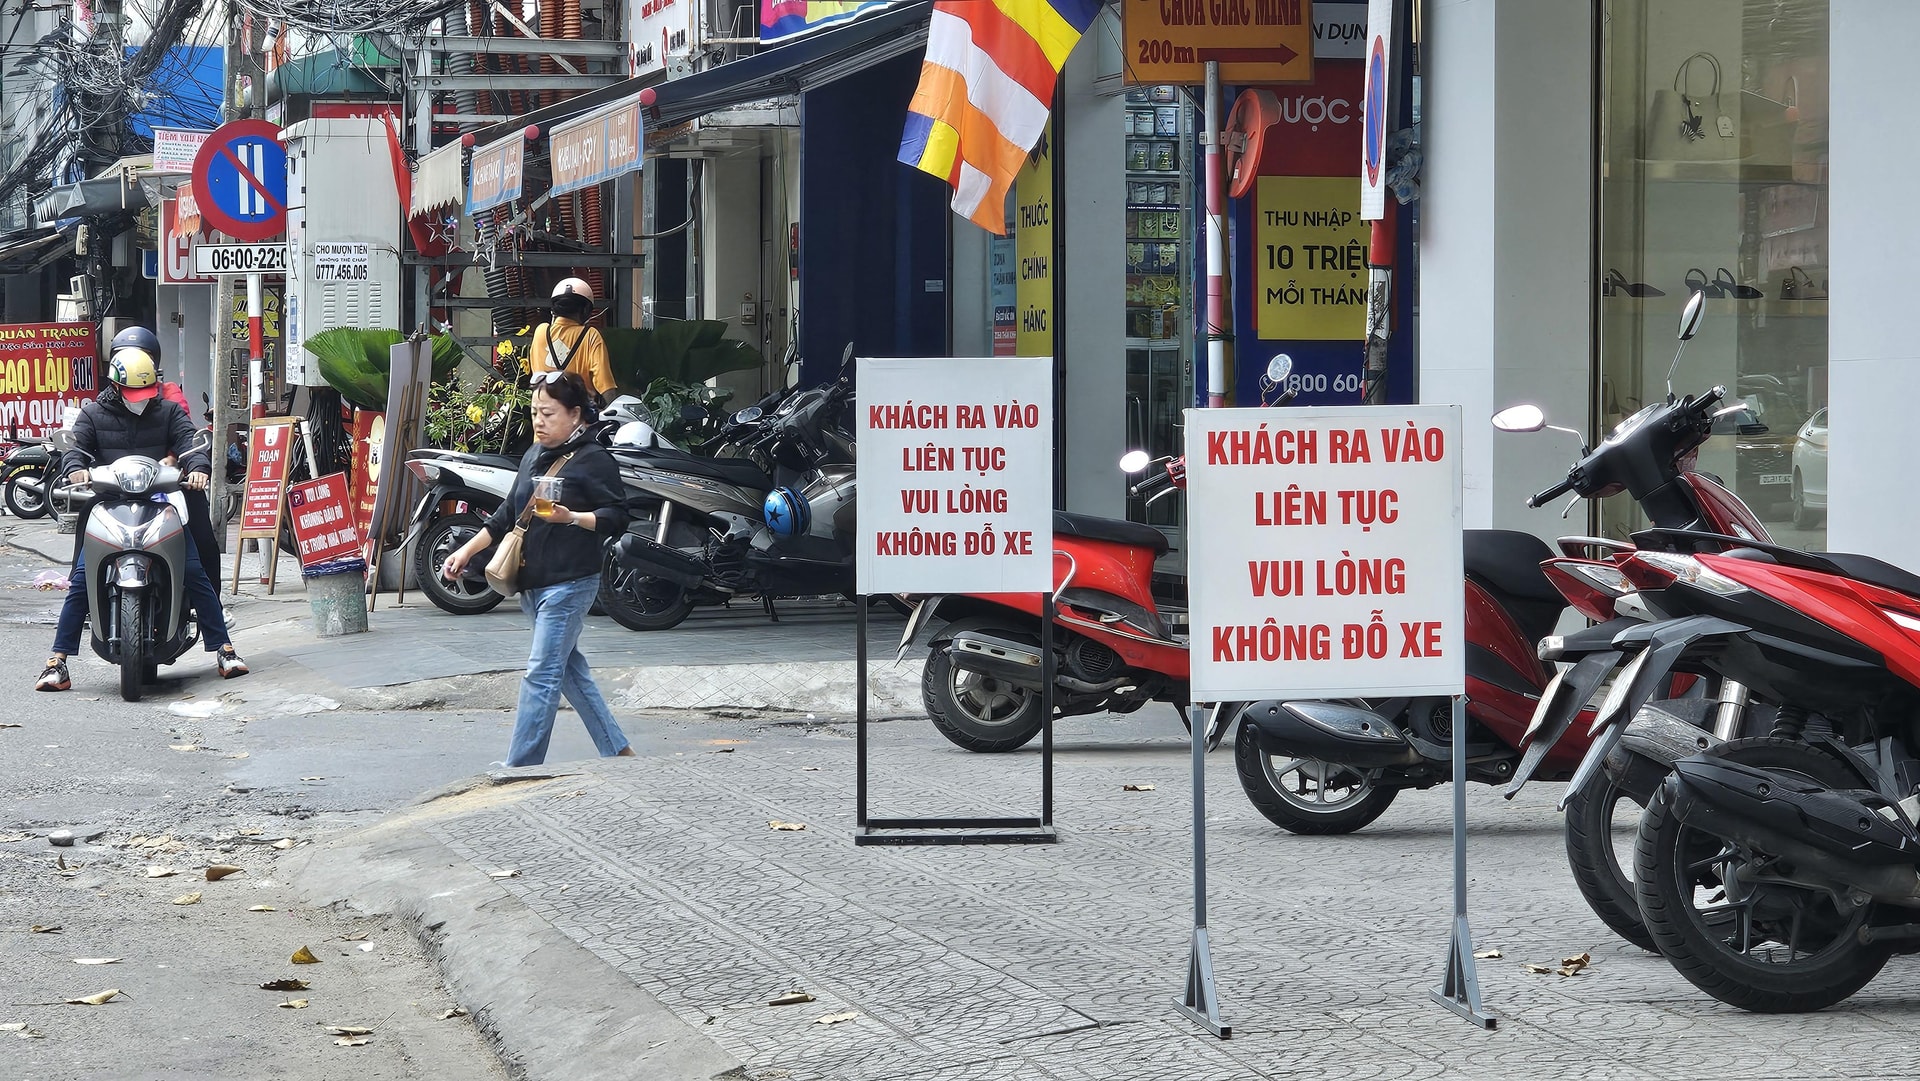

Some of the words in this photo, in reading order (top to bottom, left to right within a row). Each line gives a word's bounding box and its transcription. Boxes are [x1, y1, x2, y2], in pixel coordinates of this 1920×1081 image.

[1254, 0, 1302, 26] MINH
[1327, 23, 1368, 45] DỤN
[1138, 39, 1195, 64] 200m
[1283, 95, 1350, 132] ƯỢC
[1020, 195, 1049, 228] THUỐC
[1264, 211, 1299, 226] THU
[1303, 207, 1352, 231] NHẬP
[212, 248, 287, 270] 06:00-22:0
[316, 245, 330, 254] CHO
[331, 245, 352, 256] MƯỢN
[1267, 245, 1294, 270] 10
[316, 264, 368, 280] 0777.456.005
[1022, 251, 1048, 280] CHÍNH
[1267, 280, 1304, 305] MỖI
[40, 328, 90, 340] TRANG
[34, 349, 70, 393] LẦU
[72, 356, 95, 391] 30K
[1282, 374, 1327, 392] 1800
[869, 400, 948, 429] KHÁCH
[956, 405, 986, 429] RA
[993, 399, 1039, 428] VÀO
[1207, 423, 1318, 465] KHÁCH
[1329, 429, 1372, 463] RA
[1380, 420, 1444, 463] VÀO
[903, 442, 954, 471] LIÊN
[961, 447, 1006, 476] TỤC
[304, 487, 316, 503] VUI
[315, 482, 331, 500] LÒNG
[900, 489, 938, 513] VUI
[946, 483, 1008, 513] LÒNG
[1255, 483, 1327, 525] LIÊN
[1337, 489, 1398, 531] TỤC
[300, 540, 311, 555] XE
[876, 526, 957, 556] KHÔNG
[963, 522, 995, 555] ĐỖ
[1003, 531, 1033, 555] XE
[1248, 559, 1304, 597] VUI
[1316, 550, 1405, 595] LÒNG
[1212, 617, 1331, 662] KHÔNG
[1341, 609, 1388, 660] ĐỖ
[1399, 621, 1443, 658] XE
